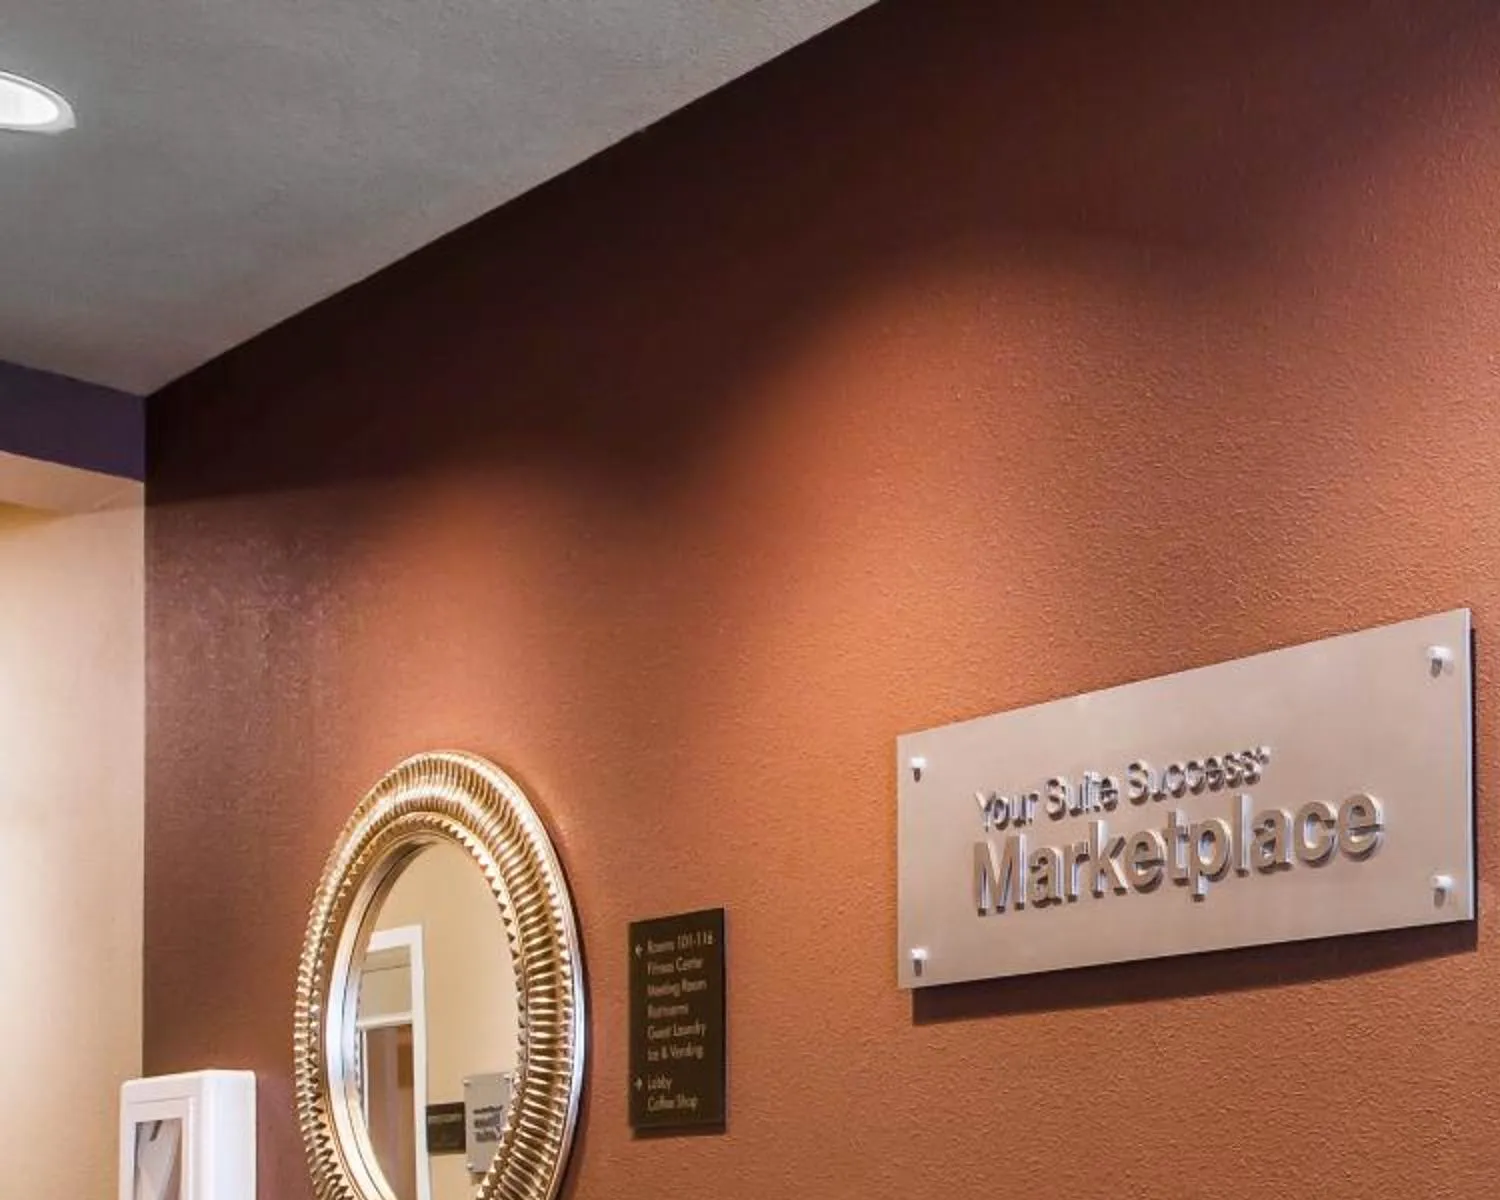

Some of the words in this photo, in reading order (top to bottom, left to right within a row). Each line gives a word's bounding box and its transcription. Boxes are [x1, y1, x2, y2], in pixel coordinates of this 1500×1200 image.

[975, 790, 1039, 833] Your
[1045, 771, 1118, 821] Suite
[974, 793, 1385, 917] Marketplace
[647, 1073, 673, 1094] Lobby
